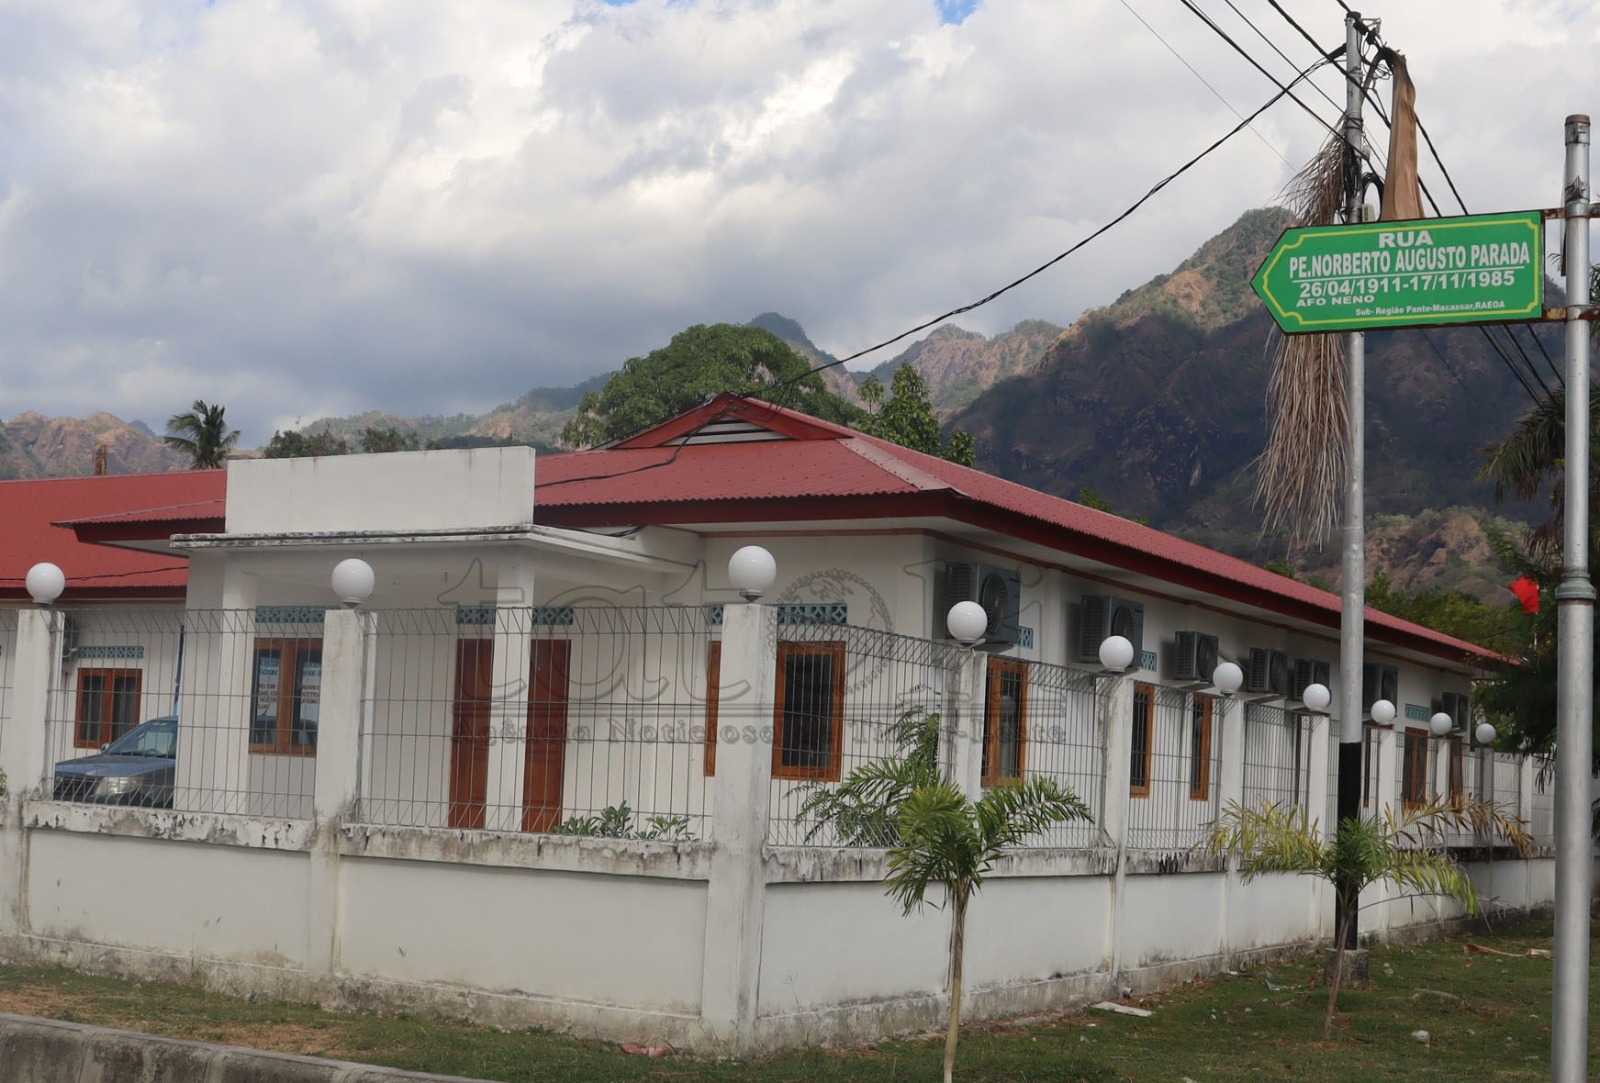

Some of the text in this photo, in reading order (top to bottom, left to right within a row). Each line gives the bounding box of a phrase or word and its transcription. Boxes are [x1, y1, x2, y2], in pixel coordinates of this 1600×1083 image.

[1379, 230, 1434, 248] RUA
[1289, 242, 1530, 279] PE.NORBERTO AUGUSTO PARADA
[1300, 270, 1515, 298] 26/04/1911-17/11/1985
[1296, 295, 1375, 307] AFO NENO
[1375, 306, 1404, 316] Região
